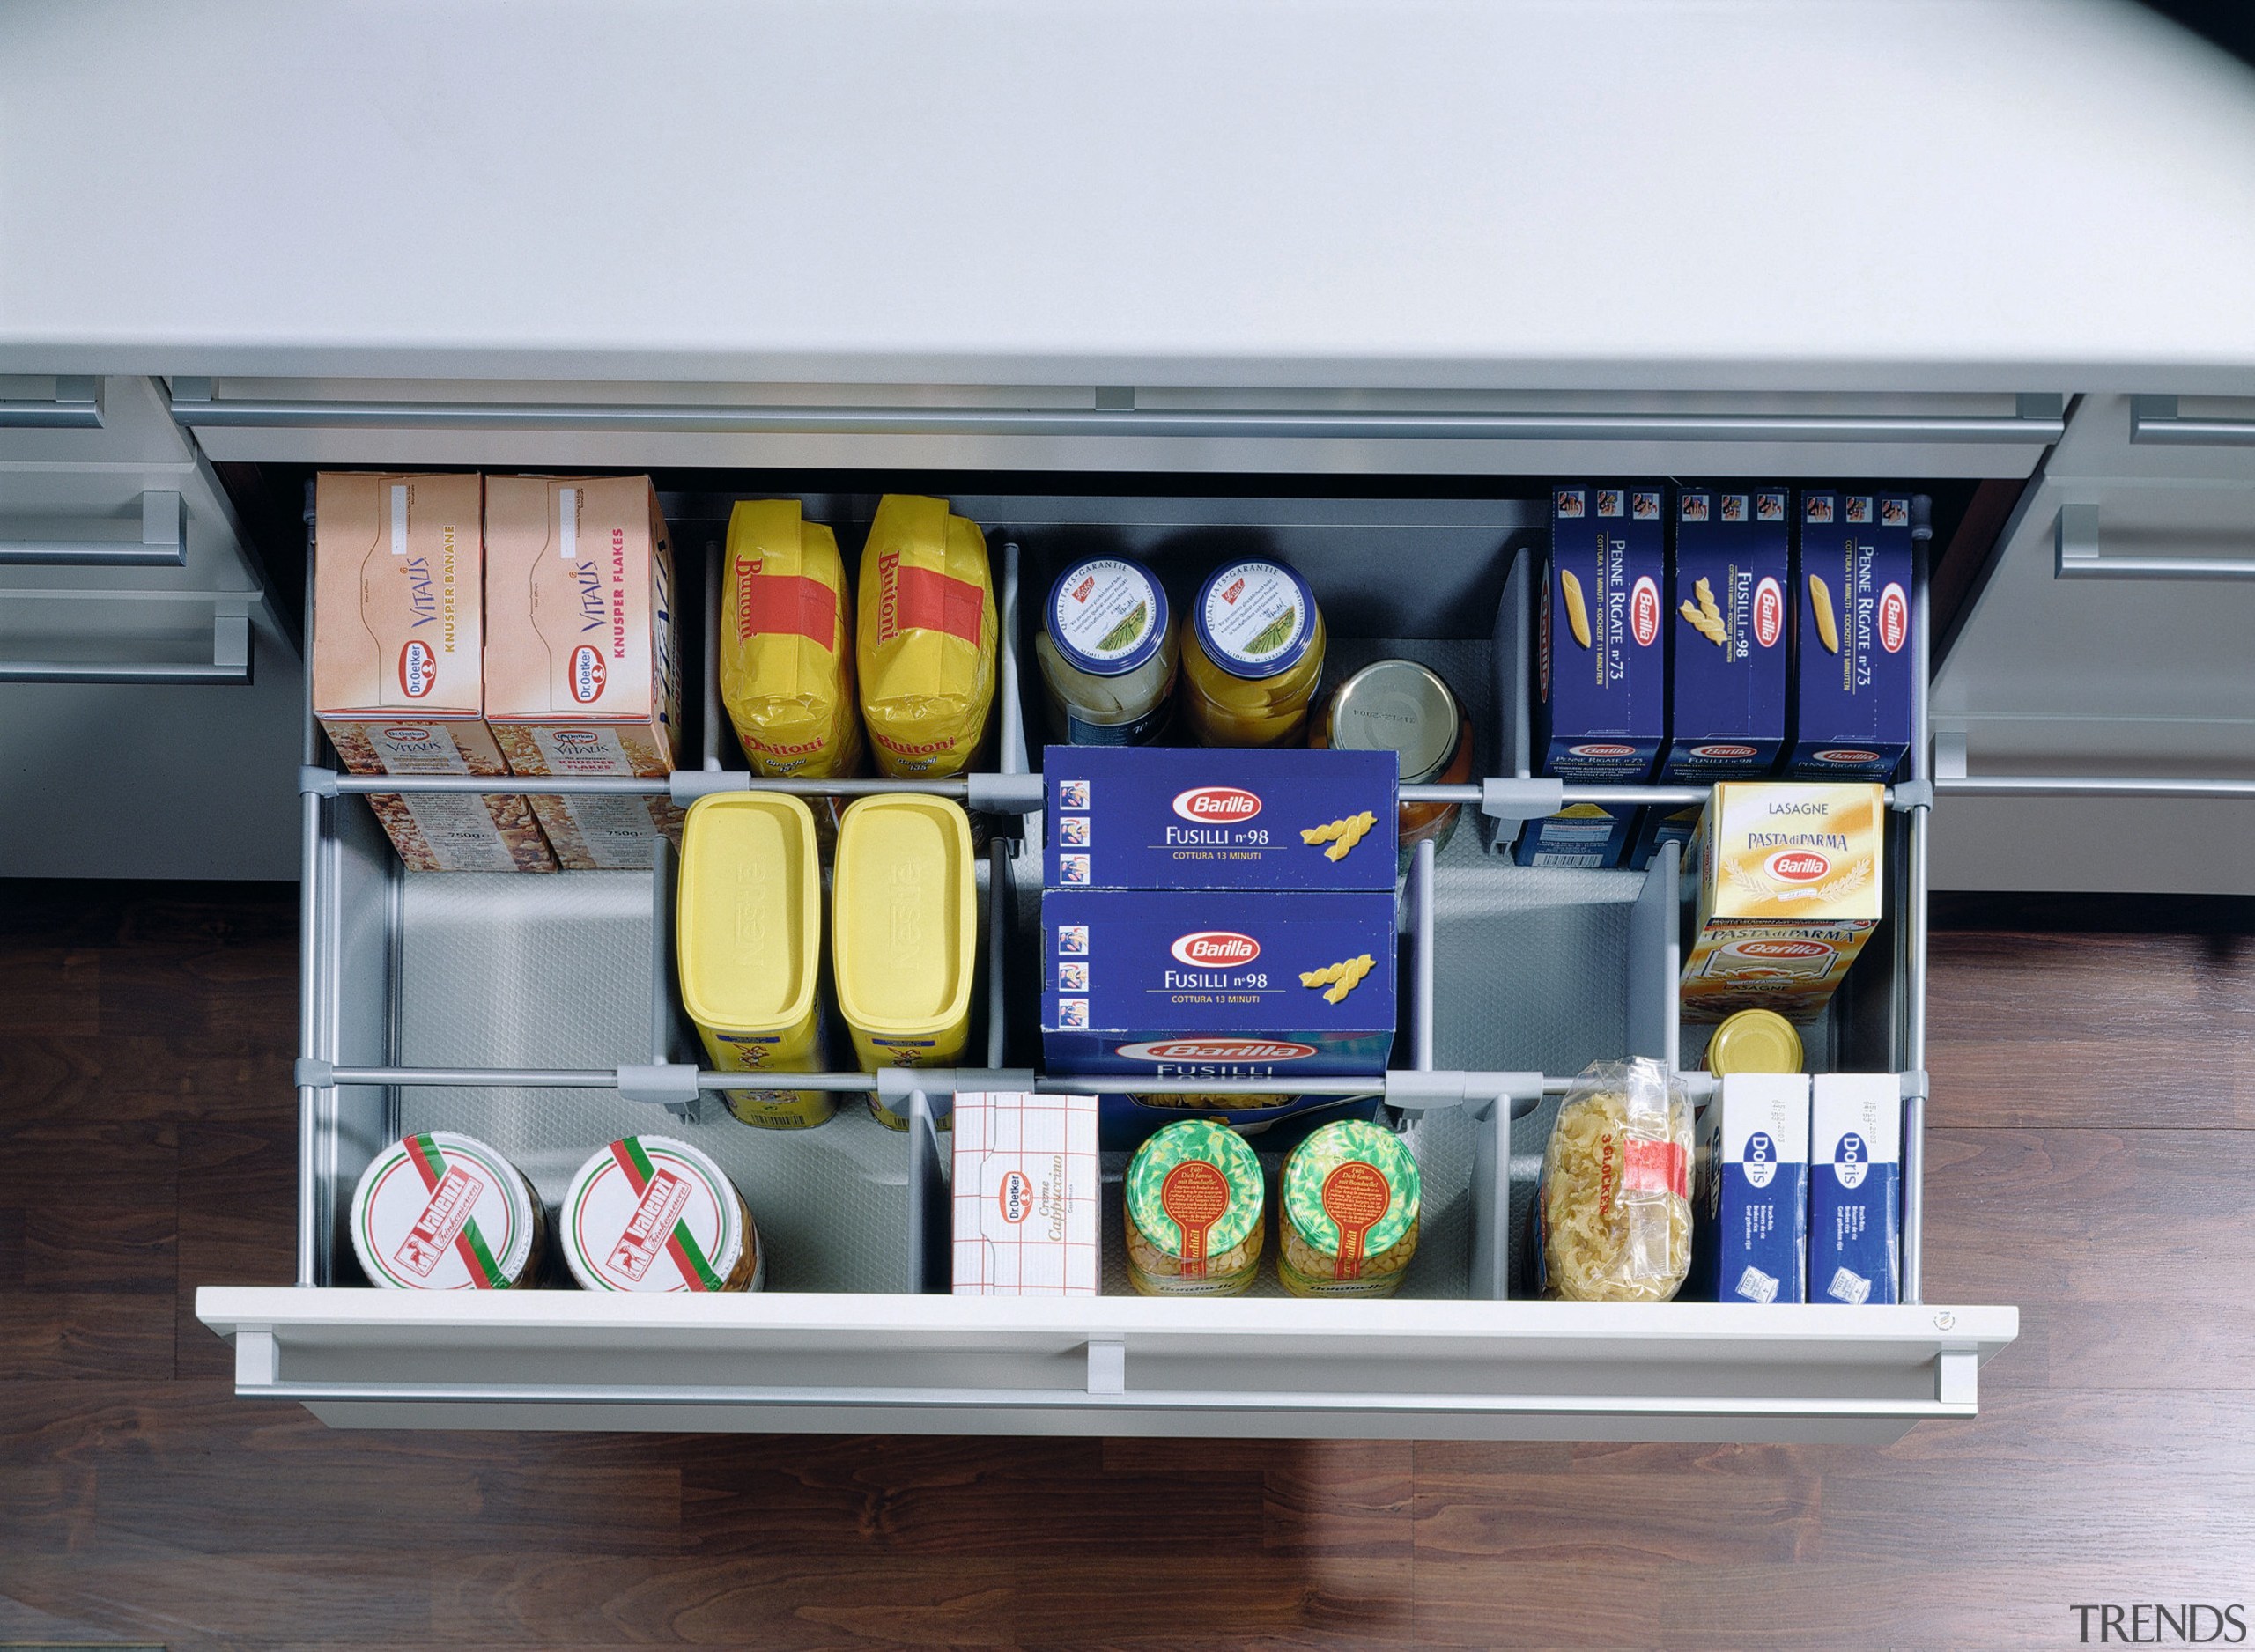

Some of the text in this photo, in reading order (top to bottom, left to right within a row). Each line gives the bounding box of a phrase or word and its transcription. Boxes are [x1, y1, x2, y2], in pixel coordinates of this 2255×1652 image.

[1610, 539, 1626, 587] PENNE
[1859, 545, 1874, 593] PENNE
[406, 557, 438, 628] VITALIS
[444, 524, 455, 653] KNUSPER BANANE
[575, 560, 607, 633] VITALIS
[612, 528, 625, 659] KNUSPER FLAKES
[879, 549, 901, 643] Buitoni
[1736, 572, 1752, 625] FUSILLI
[1610, 592, 1626, 645] RIGATE
[1638, 591, 1652, 643] Barilla
[1762, 590, 1775, 644] Barilla
[1858, 598, 1874, 651] RIGATE
[1887, 597, 1901, 649] Barilla
[410, 645, 421, 693] Dr.Oetker
[580, 650, 591, 698] Dr.Oetker
[386, 742, 442, 753] VITALIS
[876, 734, 955, 754] Buitoni
[1194, 795, 1254, 815] Barilla
[1769, 802, 1829, 815] LASAGNE
[1166, 826, 1230, 845] FUSILLI
[1172, 851, 1262, 860] COTTURA 13 MINUTI
[1778, 859, 1824, 874] Barilla
[1192, 940, 1253, 959] Barilla
[1742, 943, 1821, 955] Barilla
[1164, 970, 1228, 990] FUSILLI
[1172, 994, 1261, 1004] COTTURA 13 MINUTI
[1157, 1064, 1274, 1076] FUSILLI
[1160, 1044, 1299, 1058] Barilla
[1599, 1133, 1613, 1216] 3 GLOCKEN
[1752, 1136, 1769, 1184] Doris
[1843, 1137, 1860, 1184] Doris
[416, 1172, 465, 1236] Valenzi
[626, 1175, 675, 1240] Valenzi
[1009, 1175, 1019, 1220] Dr.Oetker
[1039, 1180, 1050, 1217] Creme
[1047, 1154, 1063, 1243] Cappuccino
[1744, 1216, 1753, 1239] gebroken
[1744, 1239, 1753, 1250] rijst
